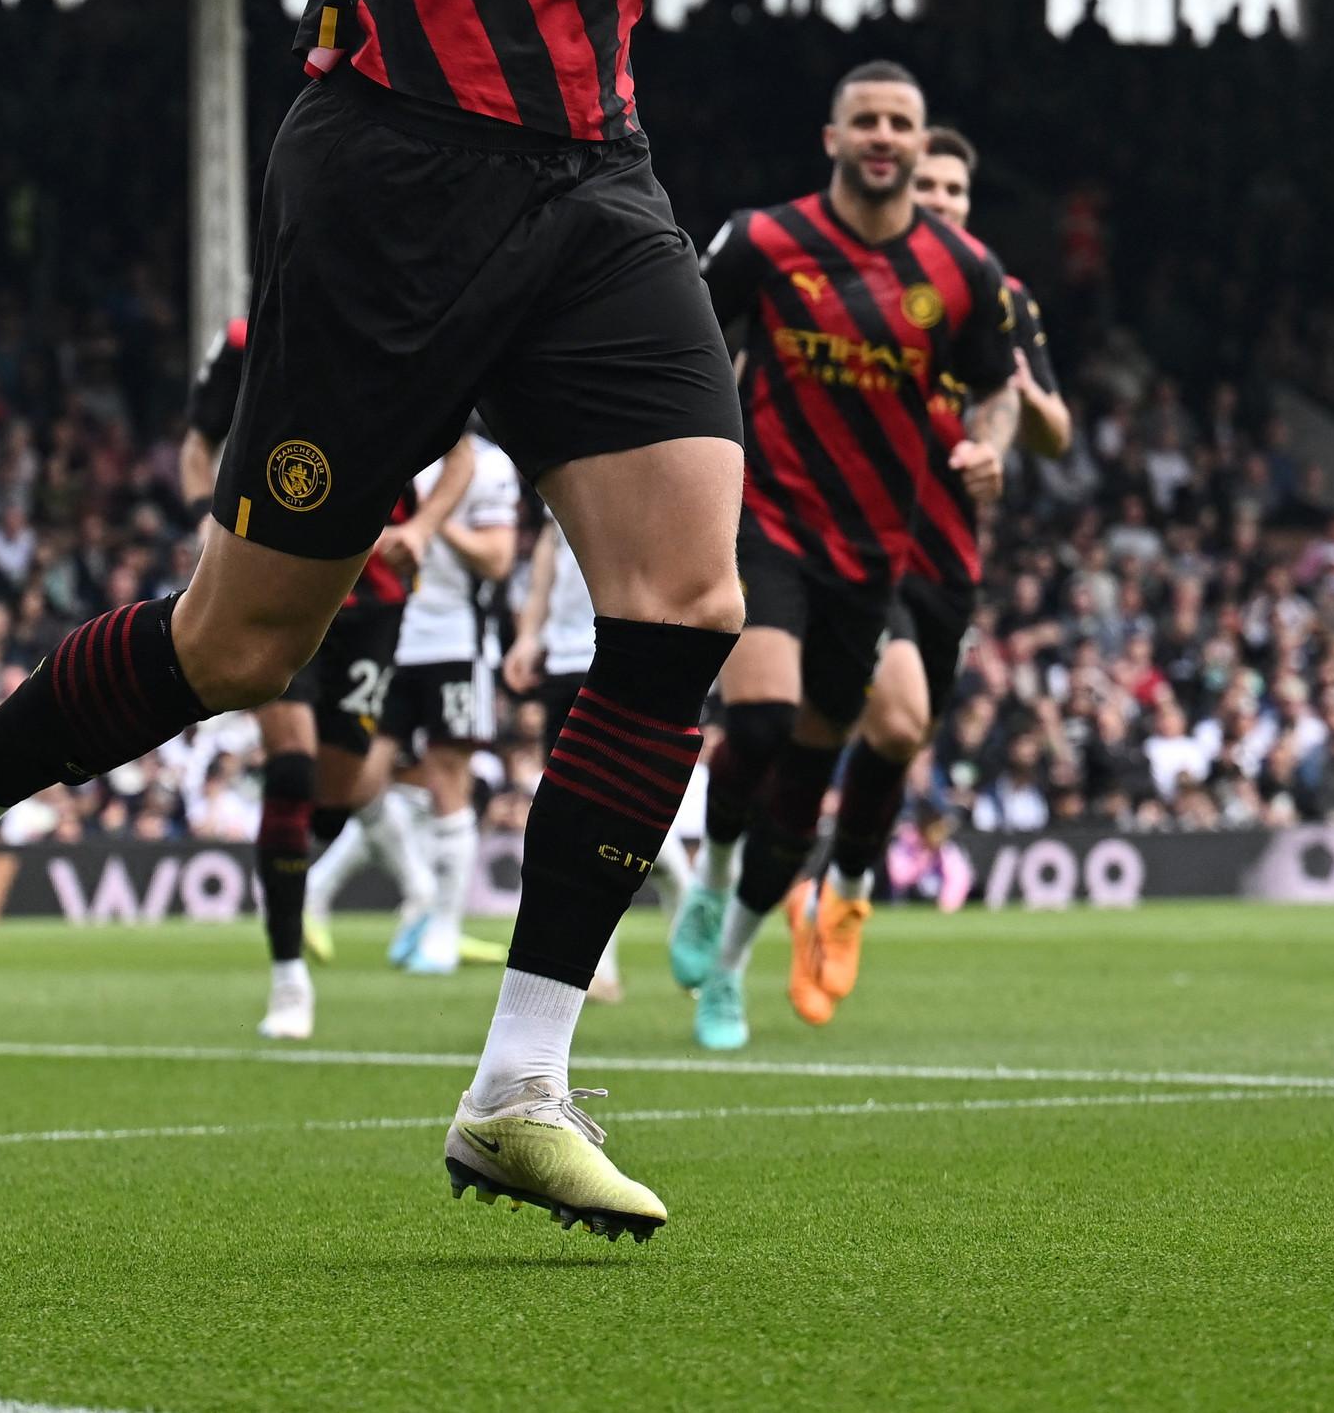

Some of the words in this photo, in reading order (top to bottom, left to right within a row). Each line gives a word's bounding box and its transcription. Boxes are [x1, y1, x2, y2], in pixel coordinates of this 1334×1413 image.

[275, 445, 325, 474] MANCHESTER
[285, 496, 304, 507] CITY
[598, 844, 654, 873] CIT
